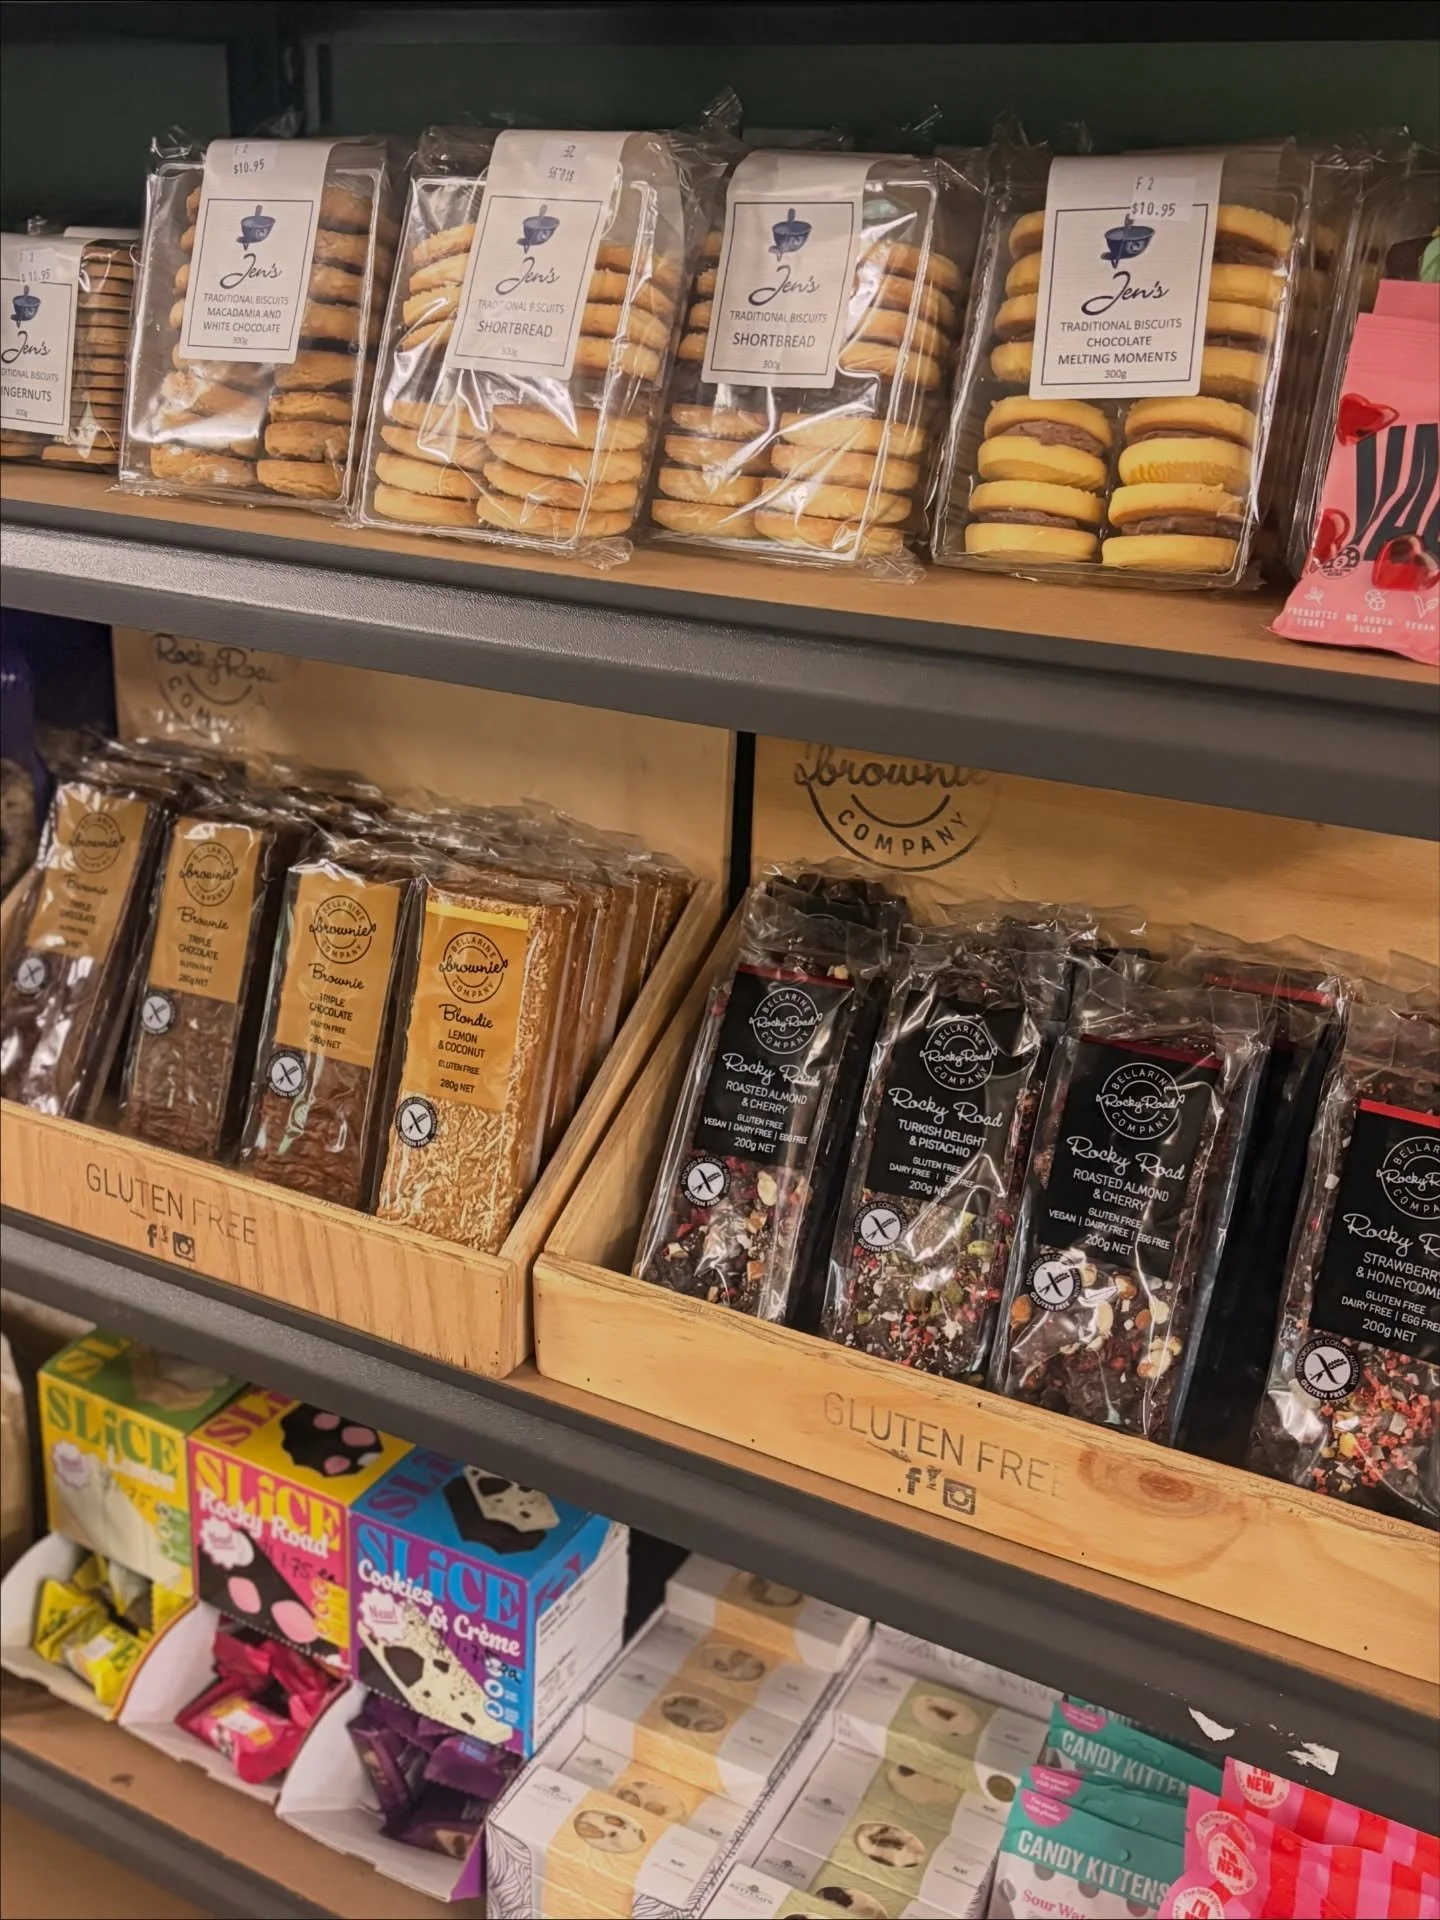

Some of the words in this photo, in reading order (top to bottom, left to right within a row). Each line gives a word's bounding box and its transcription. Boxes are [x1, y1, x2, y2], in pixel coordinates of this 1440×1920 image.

[233, 158, 265, 175] $10.95
[1136, 177, 1143, 190] F
[1147, 177, 1155, 190] 2
[1131, 202, 1176, 217] $10.95
[219, 252, 283, 290] Jen's
[495, 256, 560, 296] Jen's
[748, 264, 820, 307] Jen's
[1081, 270, 1170, 316] Jen's
[203, 292, 254, 305] TRADITIONAL
[255, 294, 289, 306] BISCUITS
[529, 301, 565, 314] BISCUITS
[207, 307, 261, 319] MACADAMIA
[263, 308, 281, 319] AND
[730, 310, 788, 323] TRADITIONAL
[790, 311, 828, 323] BISCUITS
[203, 321, 230, 331] WHITE
[232, 322, 280, 333] CHOCOLATE
[477, 320, 553, 338] SHORTBREAD
[1060, 320, 1132, 333] TRADITIONAL
[1134, 318, 1183, 330] BISCUITS
[1, 330, 51, 364] Jen's
[232, 336, 248, 346] 300g
[732, 332, 815, 349] SHORTBREAD
[1086, 336, 1152, 348] CHOCOLATE
[762, 360, 781, 371] 300g
[1058, 353, 1110, 365] MELTING
[1113, 351, 1177, 364] MOMENTS
[30, 368, 59, 382] BISCUITS
[1104, 370, 1127, 380] 300g
[838, 809, 968, 856] COMPANY
[179, 863, 239, 880] brownie
[177, 906, 229, 930] Brownie
[309, 916, 376, 937] brownie
[178, 944, 218, 960] CHOCOLATE
[451, 936, 497, 959] BELLARINE
[439, 954, 508, 974] brownie
[308, 963, 364, 990] Brownie
[452, 980, 493, 998] COMPANY
[320, 993, 345, 1007] TRIPLE
[762, 992, 812, 1014] BELLARINE
[309, 1002, 353, 1021] CHOCOLATE
[439, 1003, 494, 1029] Blondie
[331, 1025, 346, 1035] FREE
[749, 1016, 786, 1032] Rocky
[785, 1012, 822, 1027] Road
[326, 1039, 341, 1049] NET
[448, 1028, 478, 1044] LEMON
[760, 1030, 809, 1049] COMPANY
[934, 1023, 985, 1046] BELLARINE
[438, 1041, 444, 1050] &
[444, 1042, 485, 1059] COCONUT
[920, 1049, 962, 1067] Rocky
[961, 1047, 997, 1061] Road
[438, 1059, 462, 1073] GLUTEN
[461, 1064, 480, 1076] FREE
[722, 1053, 776, 1086] Rocky
[934, 1066, 987, 1085] COMPANY
[440, 1078, 459, 1092] 280g
[459, 1083, 475, 1094] NET
[725, 1080, 768, 1098] ROASTED
[768, 1090, 808, 1105] ALMOND
[741, 1097, 748, 1107] &
[749, 1099, 788, 1115] CHERRY
[888, 1087, 949, 1124] Rocky
[953, 1102, 1003, 1128] Road
[1096, 1094, 1142, 1114] Rocky
[1142, 1094, 1186, 1109] Road
[703, 1116, 727, 1129] VEGAN
[733, 1123, 754, 1136] DAIRY
[755, 1128, 772, 1139] FREE
[779, 1133, 793, 1143] EGG
[793, 1135, 808, 1145] FREE
[737, 1113, 765, 1126] GLUTEN
[765, 1119, 784, 1131] FREE
[1111, 1110, 1170, 1133] COMPANY
[898, 1118, 943, 1138] TURKISH
[943, 1128, 987, 1147] DELIGHT
[734, 1136, 757, 1152] 200g
[757, 1142, 776, 1154] NET
[909, 1136, 916, 1146] &
[918, 1137, 971, 1158] PISTACHIO
[912, 1156, 942, 1170] GLUTEN
[942, 1162, 961, 1174] FREE
[1066, 1135, 1131, 1176] Rocky
[1135, 1152, 1186, 1181] Road
[889, 1162, 911, 1175] DAIRY
[911, 1167, 931, 1179] FREE
[1376, 1169, 1427, 1191] Rocky
[908, 1180, 933, 1195] 200g
[1073, 1168, 1123, 1190] ROASTED
[1123, 1181, 1170, 1202] ALMOND
[86, 1163, 184, 1221] GLUTEN
[192, 1198, 257, 1246] FREE
[1093, 1188, 1101, 1199] &
[1102, 1191, 1147, 1211] CHERRY
[1088, 1207, 1120, 1224] GLUTEN
[1120, 1214, 1142, 1229] FREE
[1048, 1209, 1077, 1225] VEGAN
[1084, 1218, 1108, 1233] DAIRY
[1107, 1224, 1129, 1239] FREE
[1137, 1232, 1152, 1245] EGG
[1152, 1236, 1171, 1250] FREE
[1342, 1212, 1413, 1257] Rocky
[1085, 1234, 1111, 1251] 200g
[1112, 1242, 1133, 1256] NET
[1355, 1266, 1364, 1278] &
[1031, 1291, 1055, 1311] GLUTEN
[1055, 1300, 1070, 1311] FREE
[1341, 1295, 1368, 1313] DAIRY
[1369, 1303, 1392, 1318] FREE
[1401, 1312, 1420, 1326] EGG
[1365, 1290, 1401, 1308] GLUTEN
[1402, 1300, 1427, 1315] FREE
[1362, 1318, 1391, 1338] 200g
[1393, 1327, 1418, 1343] NET
[1301, 1379, 1328, 1399] GLUTEN
[1330, 1388, 1347, 1399] FREE
[823, 1392, 965, 1467] GLUTEN
[199, 1488, 264, 1538] Rocky
[271, 1515, 329, 1560] Road
[357, 1559, 433, 1607] Cookies
[429, 1604, 449, 1632] &
[453, 1614, 521, 1658] Crème
[1061, 1729, 1124, 1775] CANDY
[1247, 1774, 1275, 1796] NEW
[1018, 1829, 1085, 1876] CANDY
[1085, 1855, 1171, 1906] KITTENS
[1216, 1854, 1244, 1882] NEW
[1023, 1889, 1057, 1913] Sour
